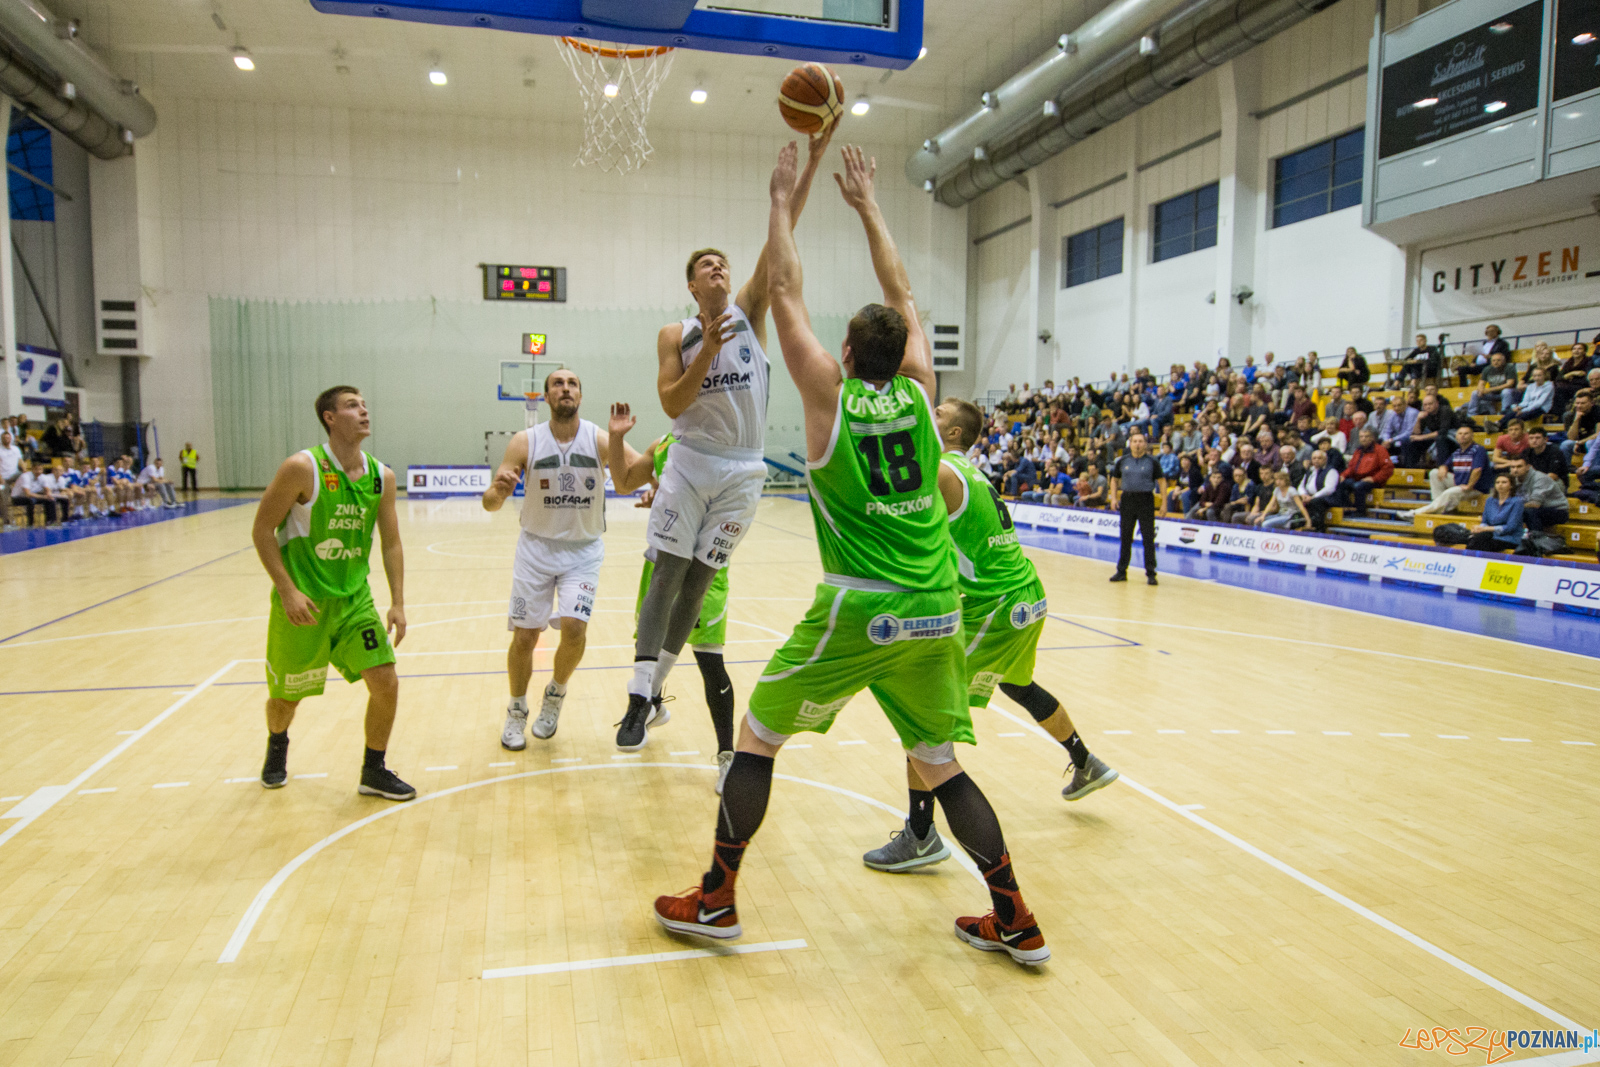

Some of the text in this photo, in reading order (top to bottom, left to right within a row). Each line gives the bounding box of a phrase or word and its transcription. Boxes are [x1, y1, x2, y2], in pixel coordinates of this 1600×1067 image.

[1433, 44, 1488, 81] Schmidt
[1490, 59, 1526, 82] SERWIS
[1432, 245, 1580, 293] CITYZEN
[701, 371, 751, 389] OFARM
[846, 388, 914, 415] UNIBEN
[858, 429, 923, 497] 18
[373, 477, 382, 495] 8
[433, 474, 486, 487] NICKEL
[558, 472, 576, 492] 12
[543, 495, 591, 505] BIOFARM
[663, 508, 679, 532] 7
[723, 523, 740, 534] KIA
[1222, 535, 1256, 550] NICKEL
[1289, 544, 1313, 556] DELIK
[1351, 552, 1380, 565] DELIK
[1403, 556, 1456, 575] funclub
[361, 628, 379, 651] 8
